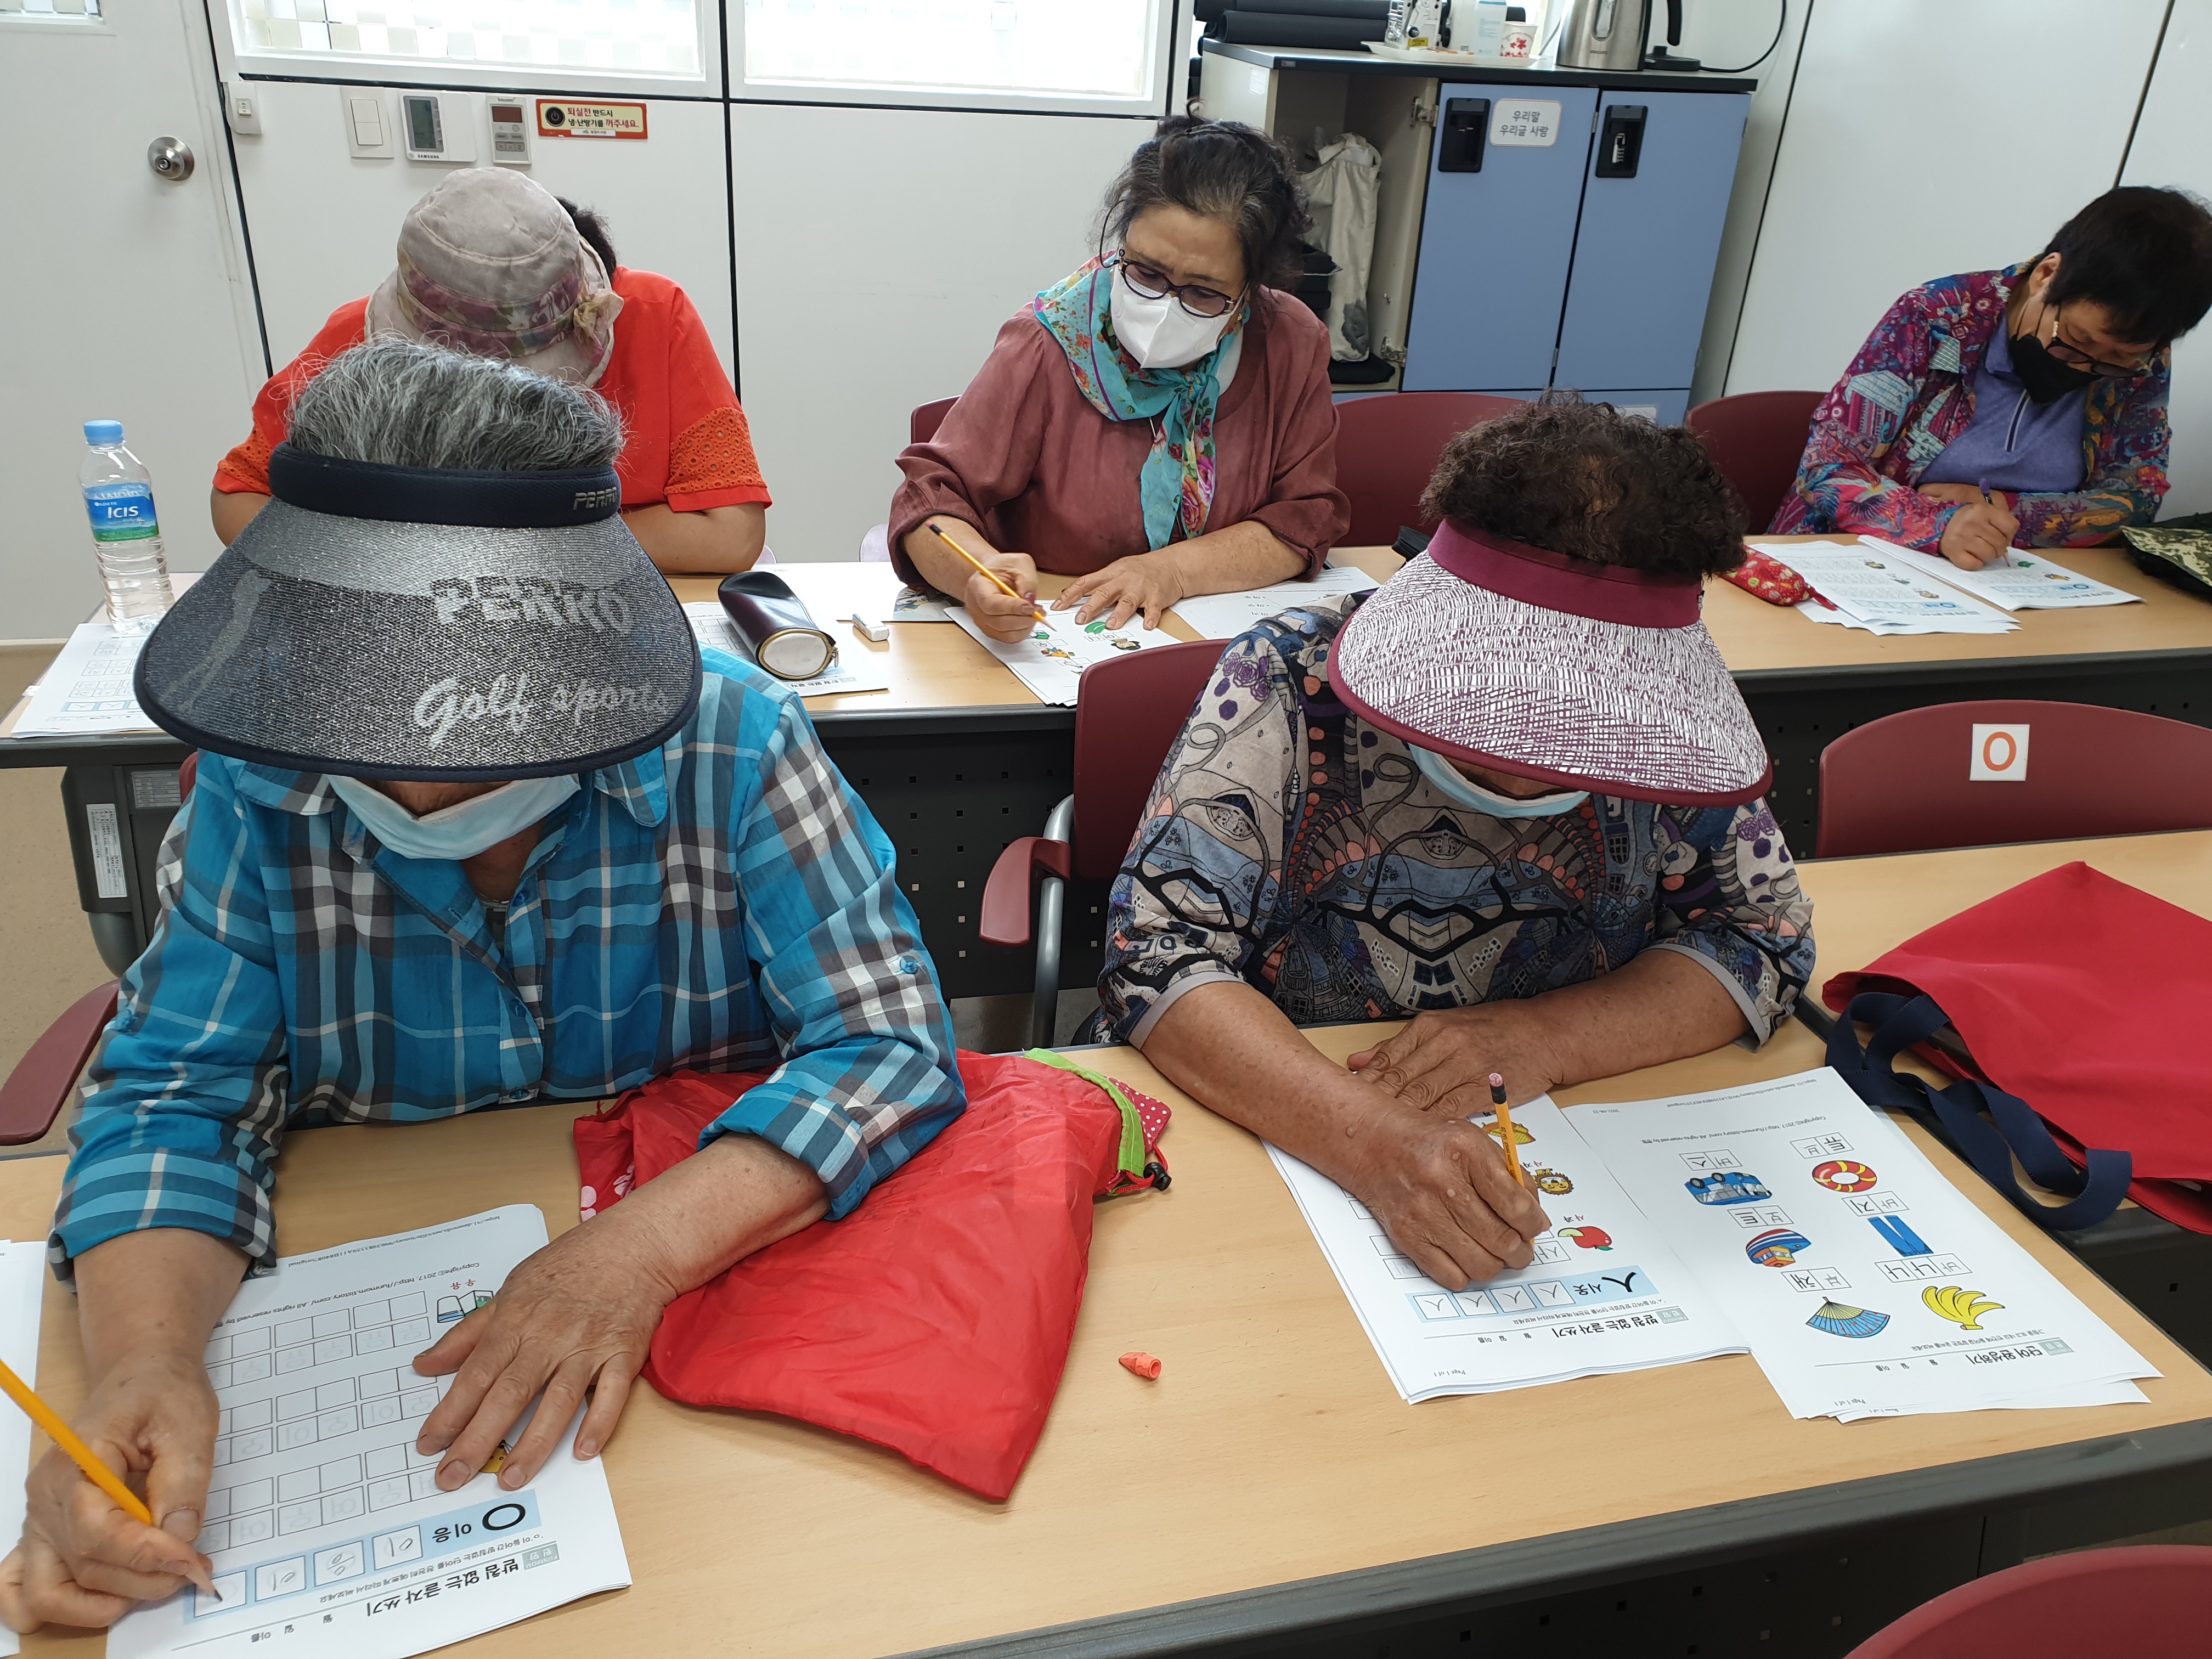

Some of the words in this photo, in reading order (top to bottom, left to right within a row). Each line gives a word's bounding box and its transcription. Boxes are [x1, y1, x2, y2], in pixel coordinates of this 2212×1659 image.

[567, 108, 591, 117] 퇴실전
[1513, 111, 1541, 123] 우리말
[1500, 125, 1527, 137] 우리글
[1530, 126, 1549, 138] 사랑
[108, 506, 139, 519] ICIS
[432, 575, 634, 633] PERRO
[414, 673, 533, 749] Golf
[550, 679, 668, 725] sports
[1804, 1136, 1846, 1155] 튜브
[1687, 1156, 1733, 1167] 버스
[1849, 1199, 1899, 1214] 바지
[1732, 1211, 1784, 1224] 보트
[1884, 1261, 1961, 1279] 바나나
[1789, 1273, 1841, 1289] 부채
[311, 1277, 415, 1306] http://funmom.tistory.com/
[1573, 1283, 1602, 1296] 시옷
[273, 1305, 295, 1313] rights
[237, 1310, 272, 1323] reserved
[1630, 1314, 1658, 1328] 받침
[1578, 1322, 1605, 1335] 글자
[1605, 1319, 1632, 1330] 없는
[1551, 1327, 1577, 1338] 쓰기
[1965, 1349, 2016, 1365] 완성하기
[2013, 1346, 2043, 1358] 단어
[432, 1522, 472, 1543] 이응
[497, 1538, 520, 1550] 들어간
[463, 1547, 495, 1561] 받침없는
[438, 1557, 461, 1570] 단어를
[525, 1555, 557, 1569] FUNMOM
[410, 1565, 435, 1578] 천천히
[485, 1558, 518, 1580] 받침
[356, 1581, 381, 1592] 따라서
[445, 1571, 479, 1590] 없는
[319, 1587, 354, 1603] 써보세요
[405, 1582, 441, 1605] 글자
[366, 1595, 401, 1617] 쓰기
[323, 1614, 333, 1624] 월
[284, 1624, 294, 1635] 일
[250, 1631, 271, 1643] 이름
